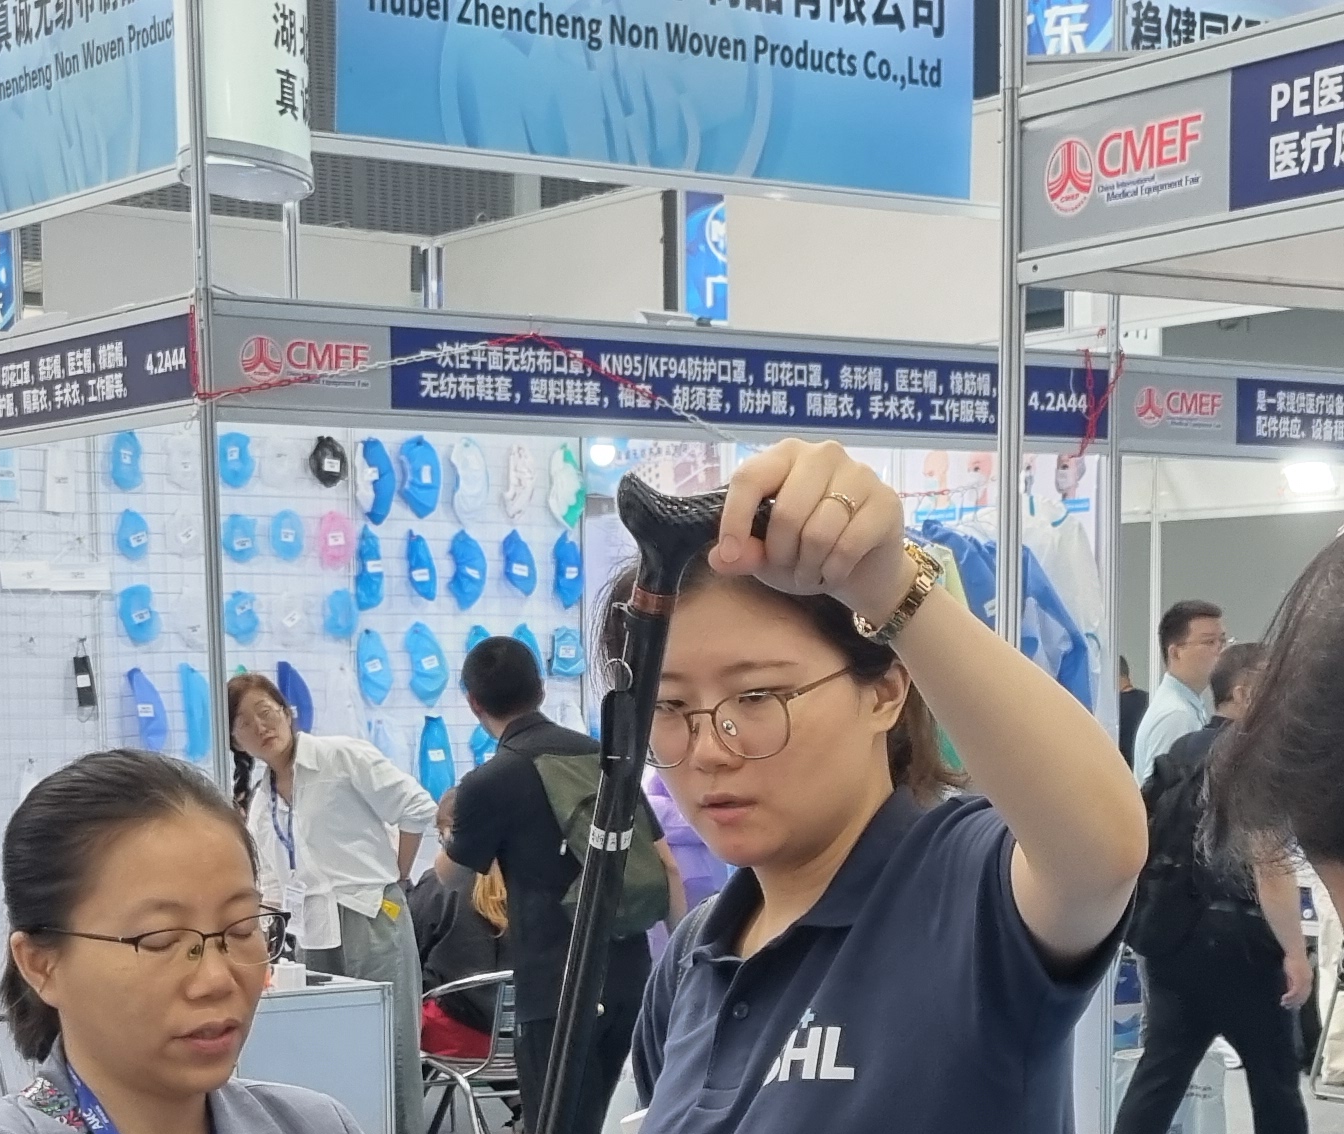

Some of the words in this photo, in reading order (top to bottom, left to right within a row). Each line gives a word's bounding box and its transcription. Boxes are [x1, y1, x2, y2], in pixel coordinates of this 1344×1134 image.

[55, 50, 81, 80] Non
[82, 40, 126, 71] Woven
[456, 0, 603, 51] Zhencheng
[608, 13, 659, 50] Non
[664, 22, 748, 63] Woven
[753, 34, 858, 77] Products
[862, 50, 944, 90] Co.,Ltd
[1097, 113, 1203, 179] CMEF
[1106, 187, 1139, 202] Medical
[1140, 177, 1183, 198] Equipment
[1184, 173, 1201, 187] Fair
[145, 346, 187, 375] 4.2A44
[286, 340, 371, 372] CMEF
[1028, 390, 1089, 415] 4.2A44
[1166, 391, 1222, 419] CMEF
